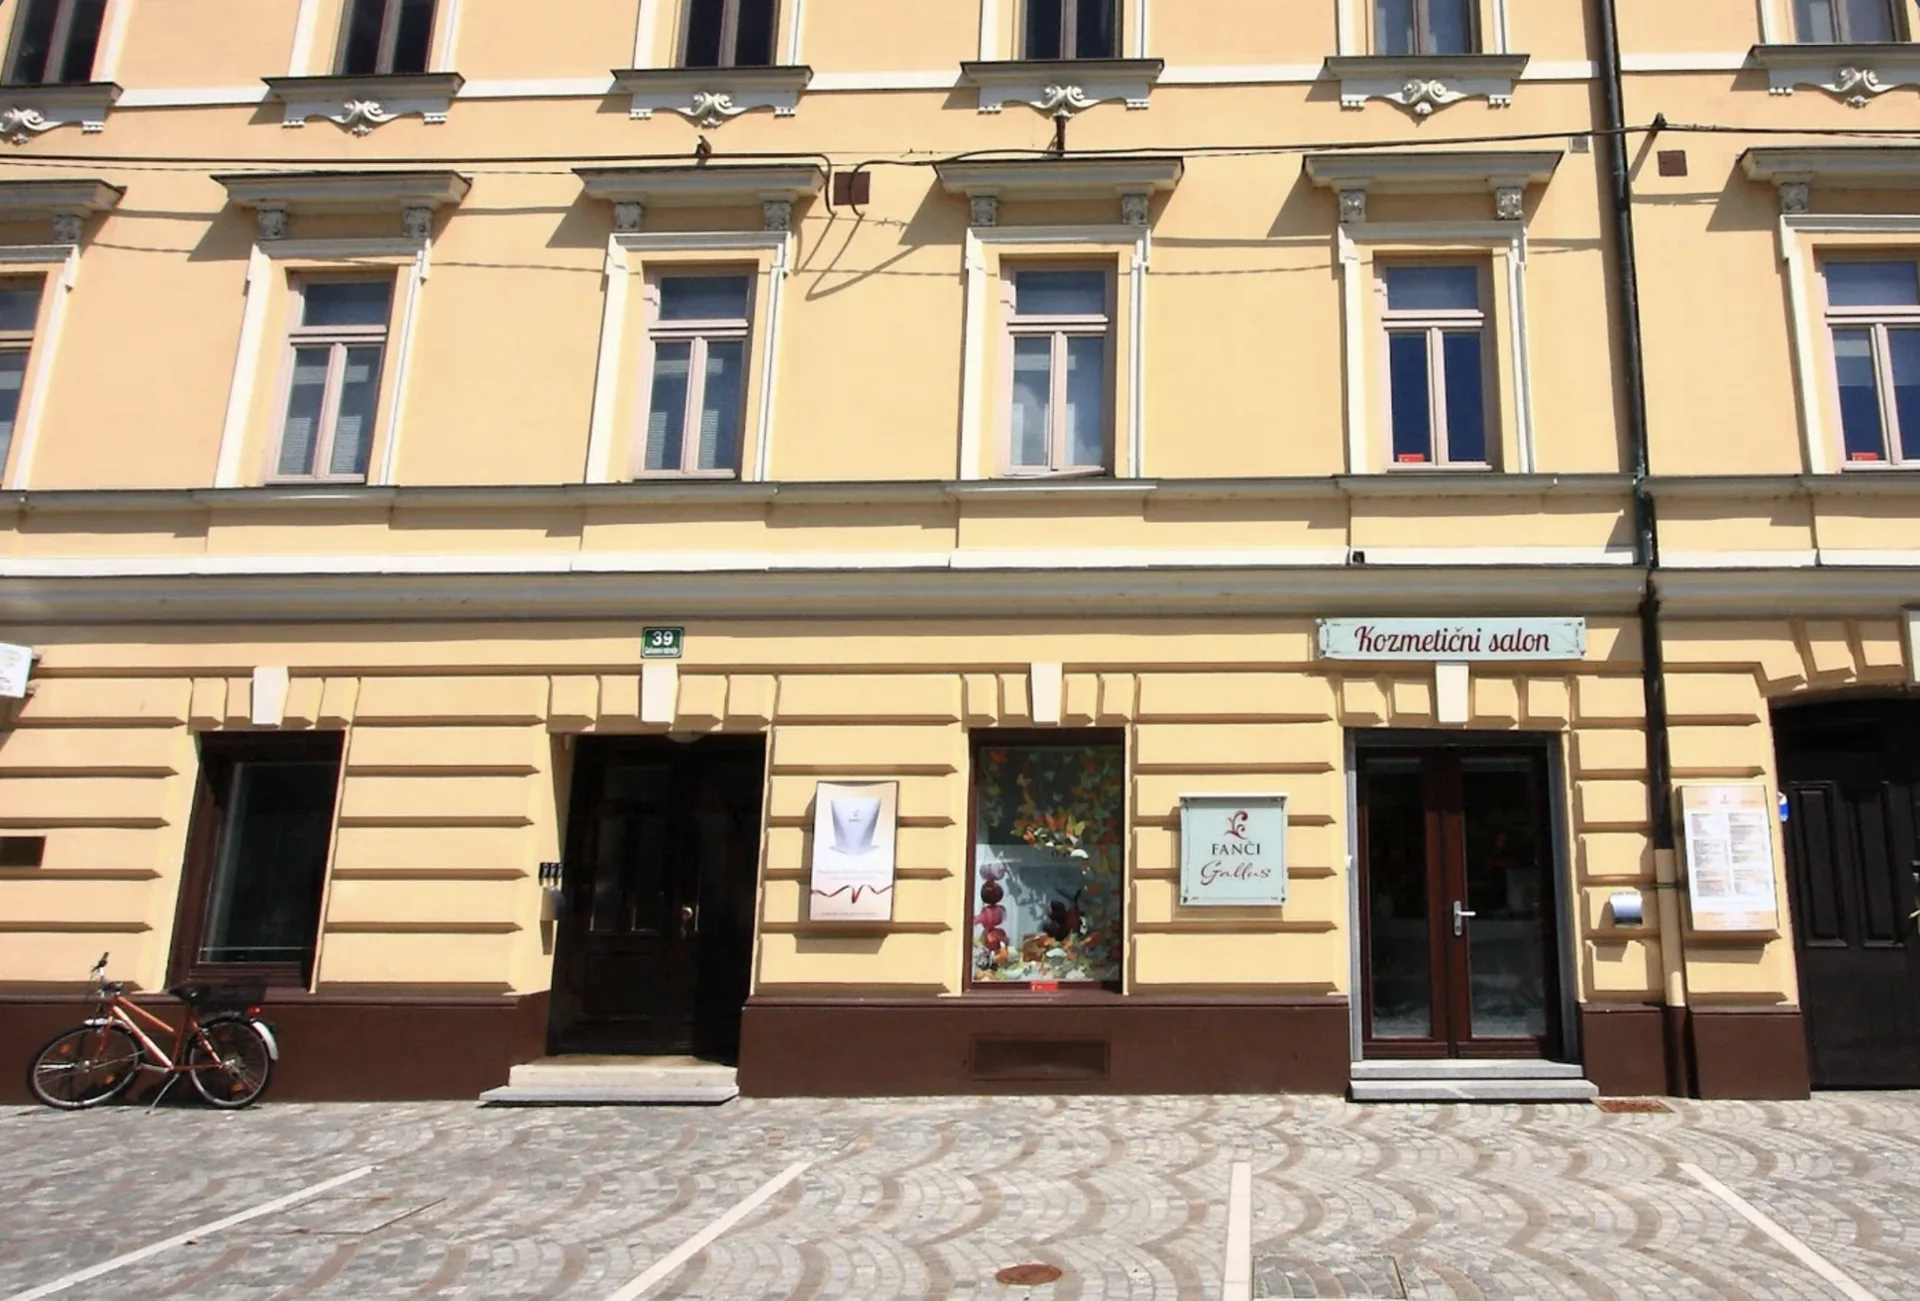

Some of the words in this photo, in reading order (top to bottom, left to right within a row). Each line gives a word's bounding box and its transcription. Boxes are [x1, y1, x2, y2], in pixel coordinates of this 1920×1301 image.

[652, 630, 674, 646] 39
[1354, 626, 1482, 652] Kozmetični
[1489, 628, 1550, 652] salon
[1200, 860, 1271, 886] Gallus
